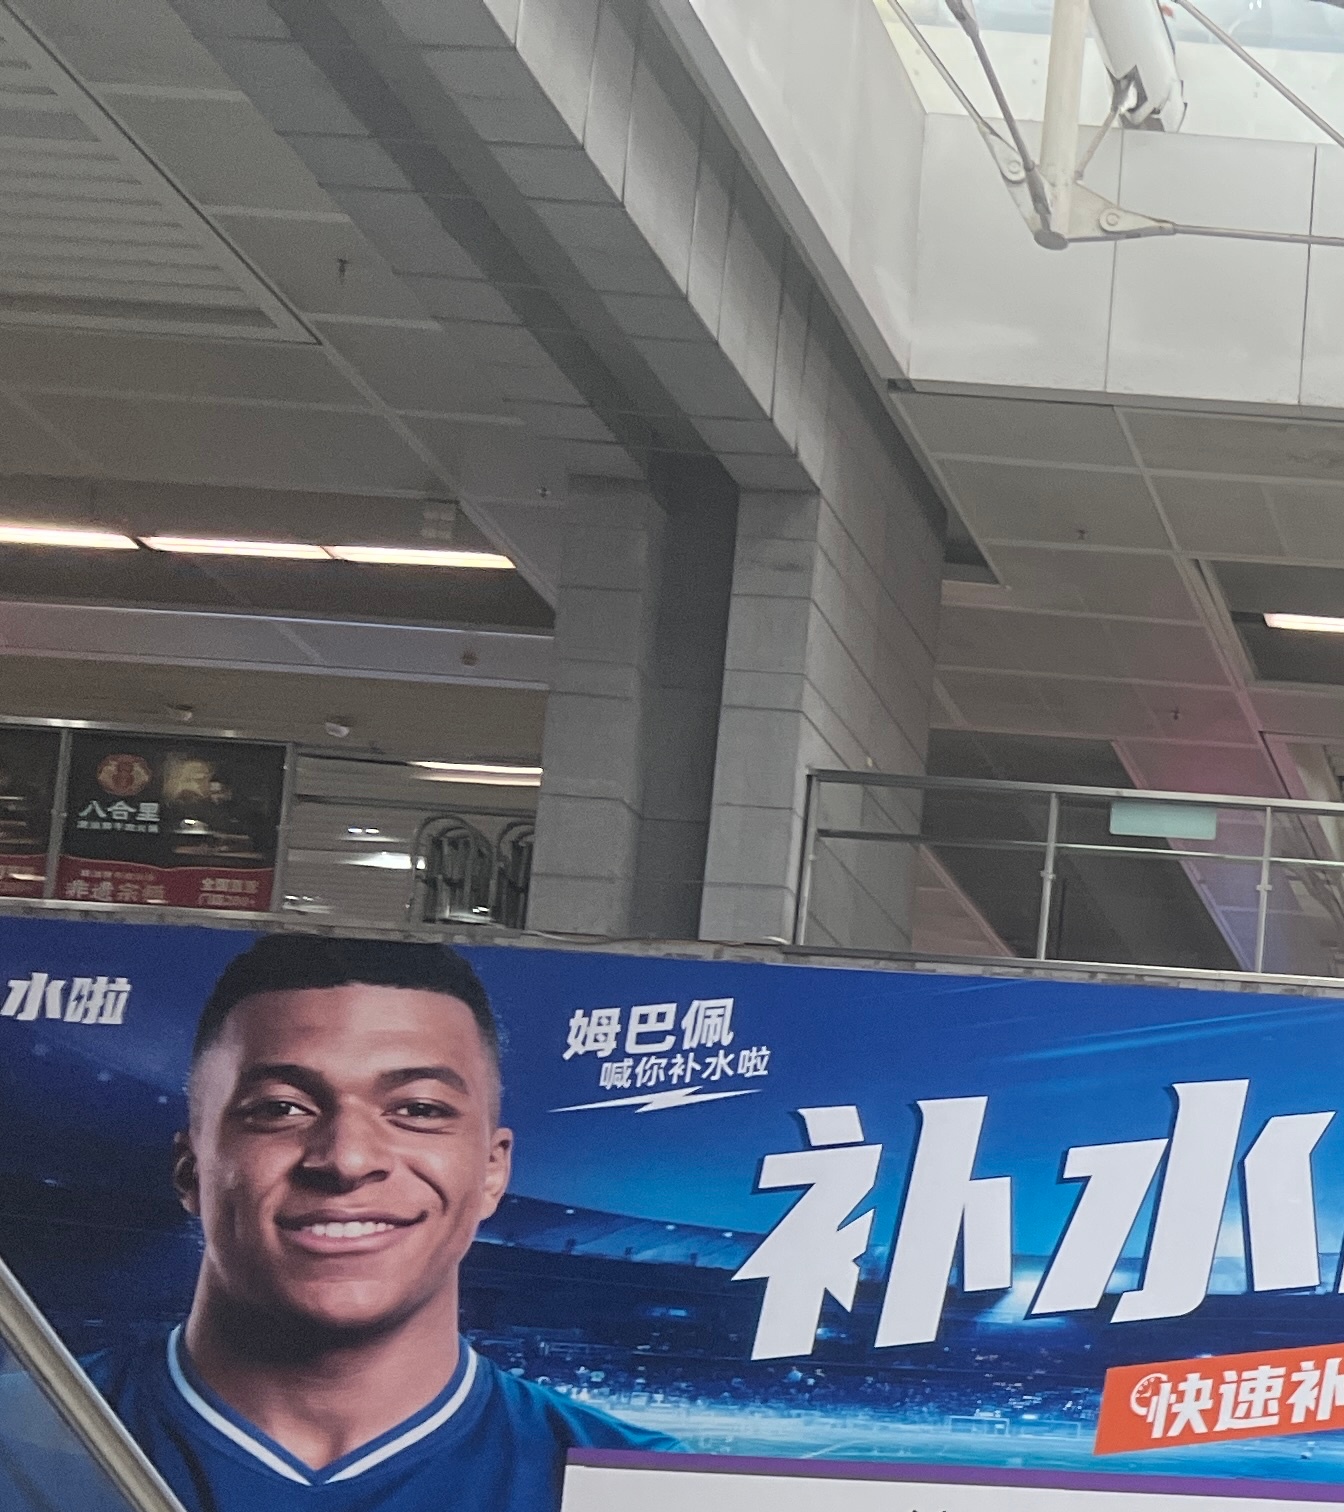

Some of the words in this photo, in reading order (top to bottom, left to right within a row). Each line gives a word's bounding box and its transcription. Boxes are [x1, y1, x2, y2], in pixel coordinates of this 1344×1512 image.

[78, 800, 161, 822] 八合里
[0, 971, 132, 1025] 水啦
[562, 997, 735, 1060] 姆巴佩
[599, 1046, 771, 1090] 喊你补水啦
